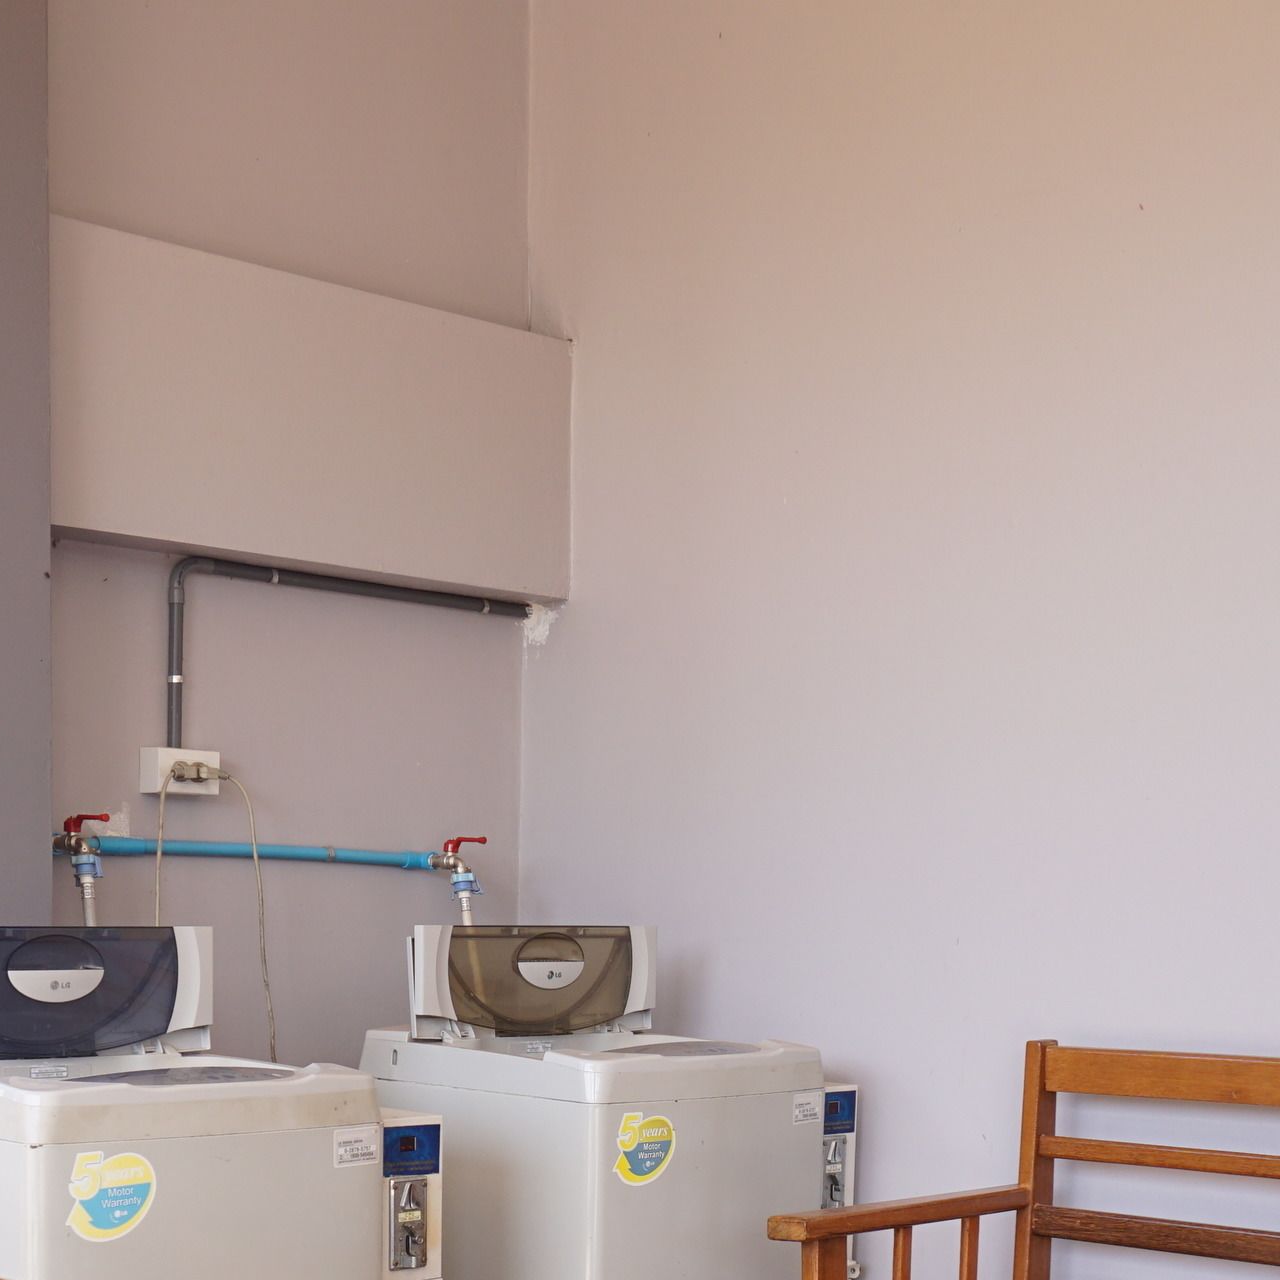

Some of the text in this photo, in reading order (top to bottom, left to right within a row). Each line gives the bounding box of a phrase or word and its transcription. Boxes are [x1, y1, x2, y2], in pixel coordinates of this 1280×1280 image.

[617, 1112, 643, 1152] 5
[643, 1143, 662, 1151] Motor
[637, 1150, 665, 1160] Warranty
[69, 1151, 103, 1200] 5
[108, 1187, 134, 1198] Motor
[101, 1197, 142, 1209] Warranty
